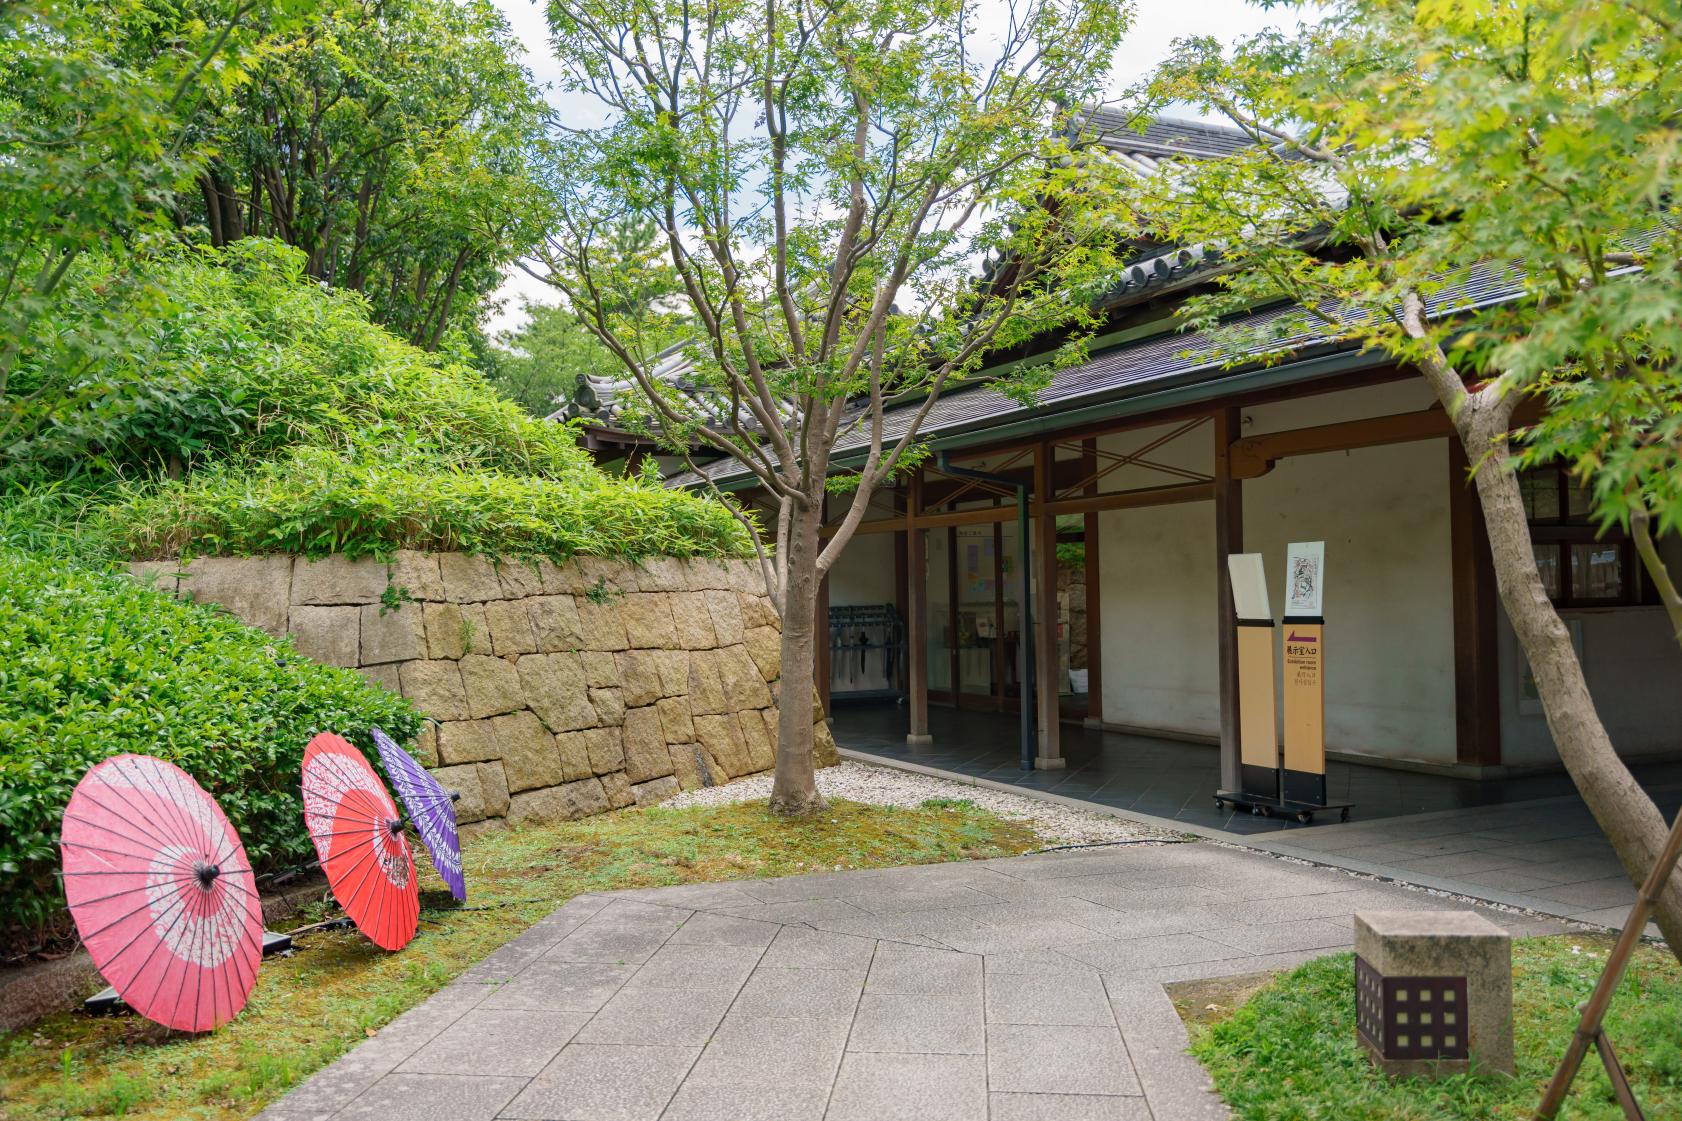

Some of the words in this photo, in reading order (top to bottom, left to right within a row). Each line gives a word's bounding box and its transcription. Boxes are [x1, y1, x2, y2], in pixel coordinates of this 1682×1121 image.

[1287, 645, 1317, 656] 展示室入口
